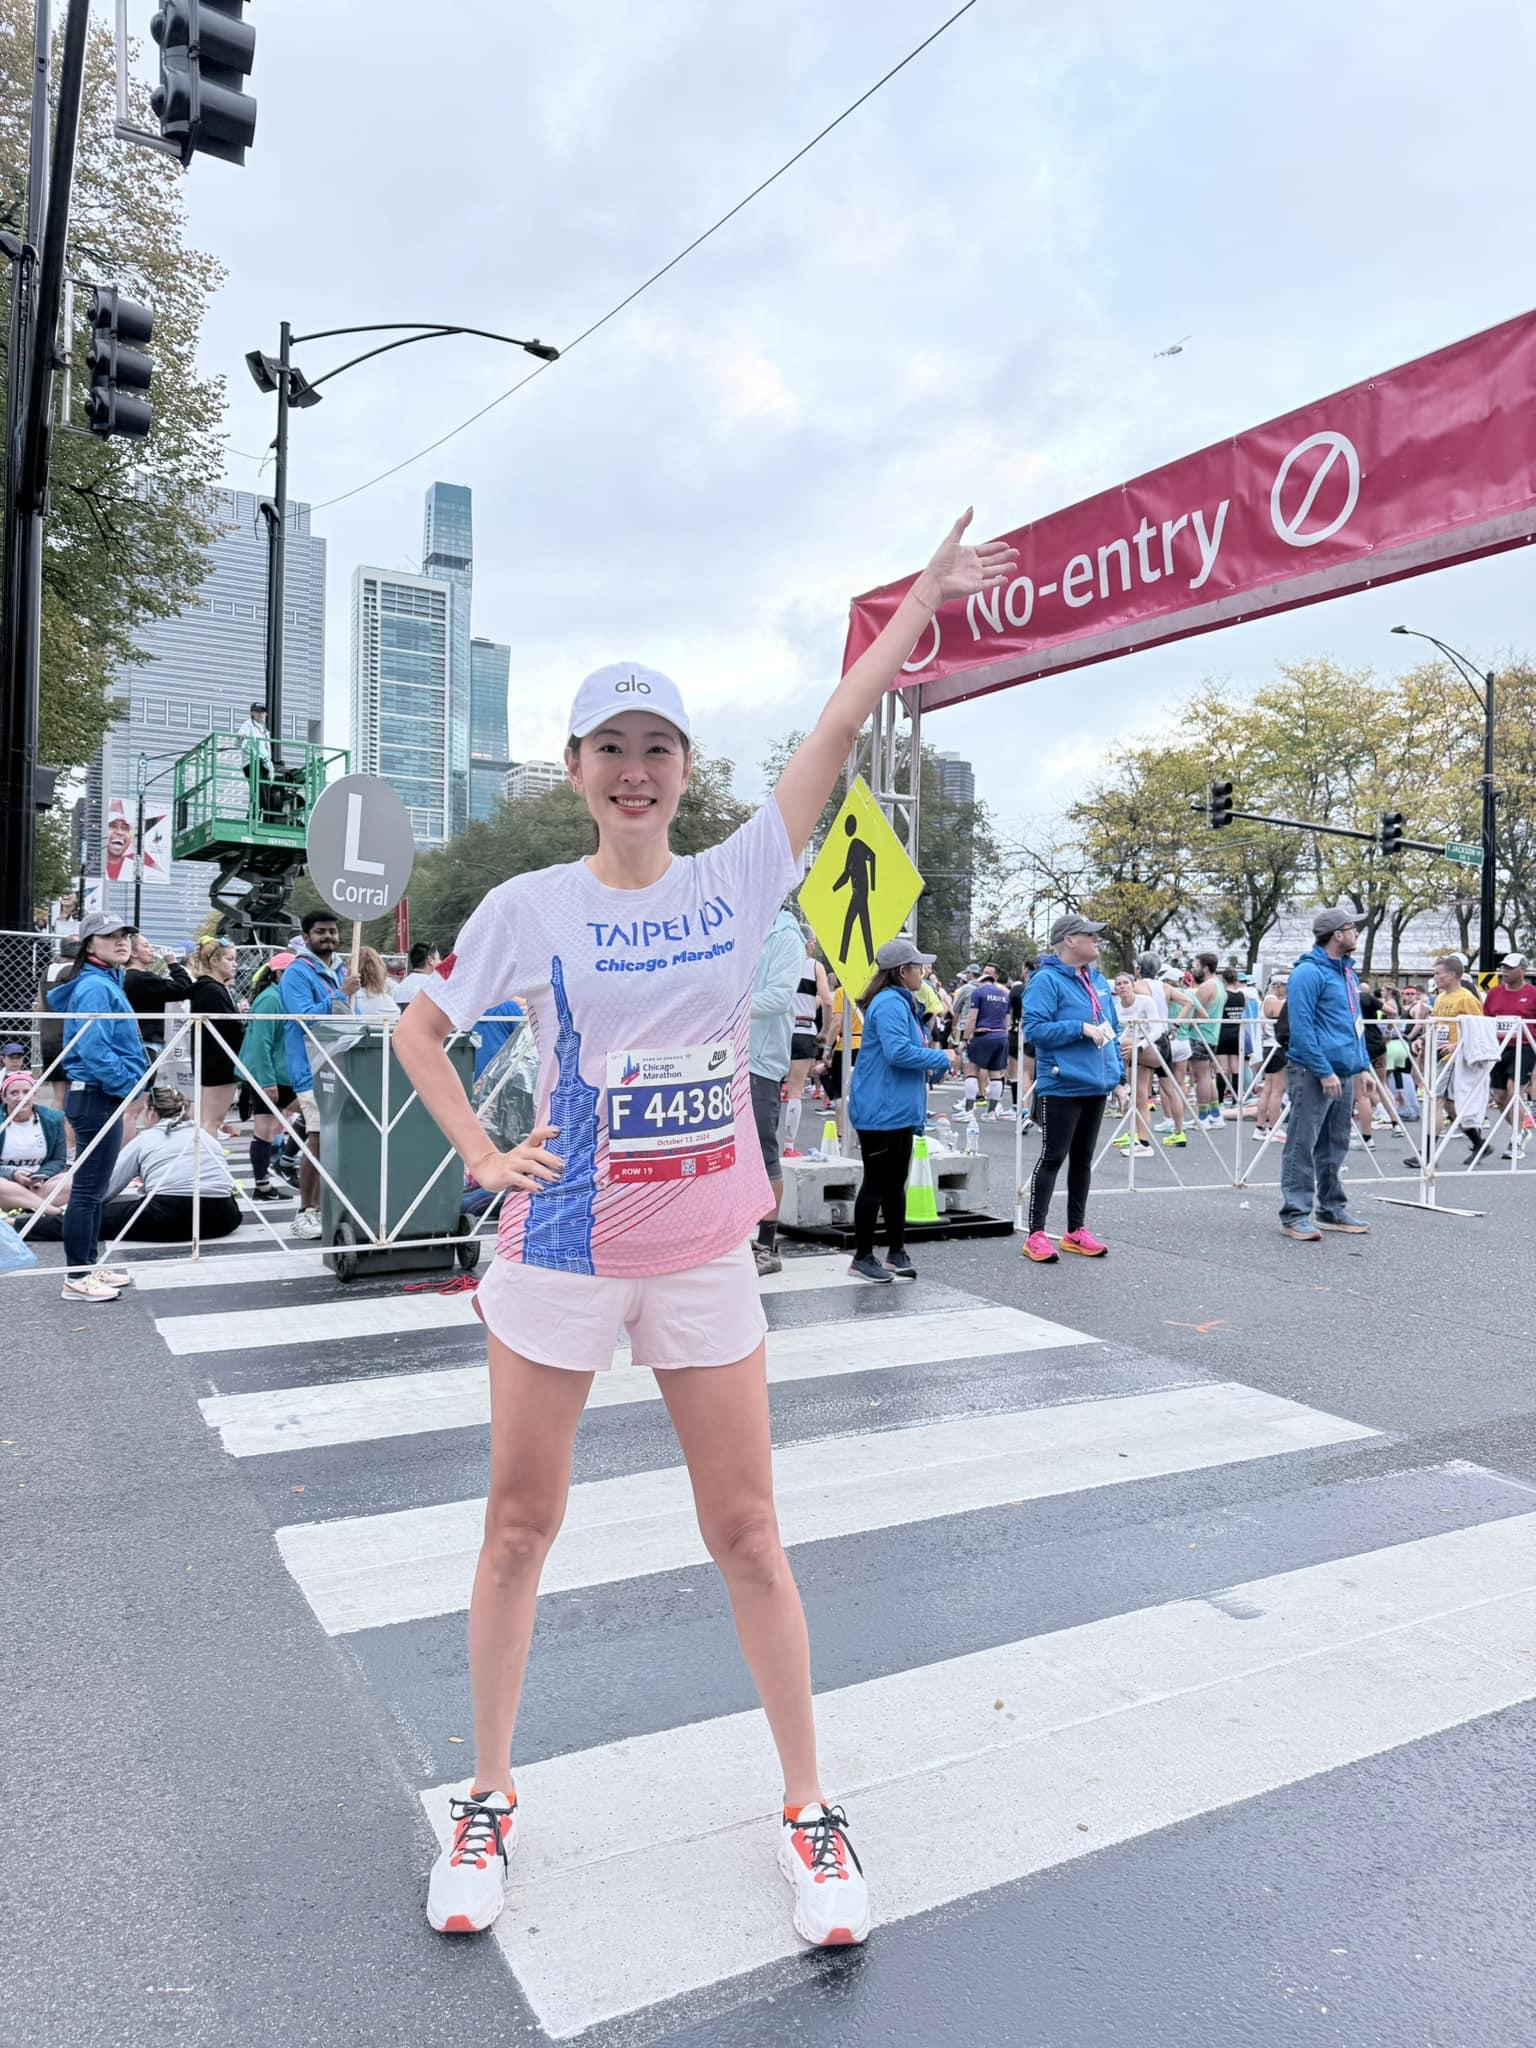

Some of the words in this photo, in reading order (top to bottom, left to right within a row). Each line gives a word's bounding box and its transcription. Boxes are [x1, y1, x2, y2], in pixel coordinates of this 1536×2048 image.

[966, 499, 1230, 641] No-entry
[615, 674, 651, 695] alo
[343, 792, 385, 876] L
[332, 878, 389, 906] Corral
[586, 914, 690, 947] TAIPEI
[698, 896, 735, 936] 101
[595, 958, 668, 972] Chicago
[672, 938, 735, 966] Maratho
[712, 1049, 727, 1061] RUN
[642, 1063, 674, 1072] Chicago
[643, 1071, 682, 1080] Marathon
[612, 1095, 632, 1130] F
[644, 1082, 732, 1128] 44388
[657, 1137, 683, 1146] October
[621, 1167, 641, 1176] ROW
